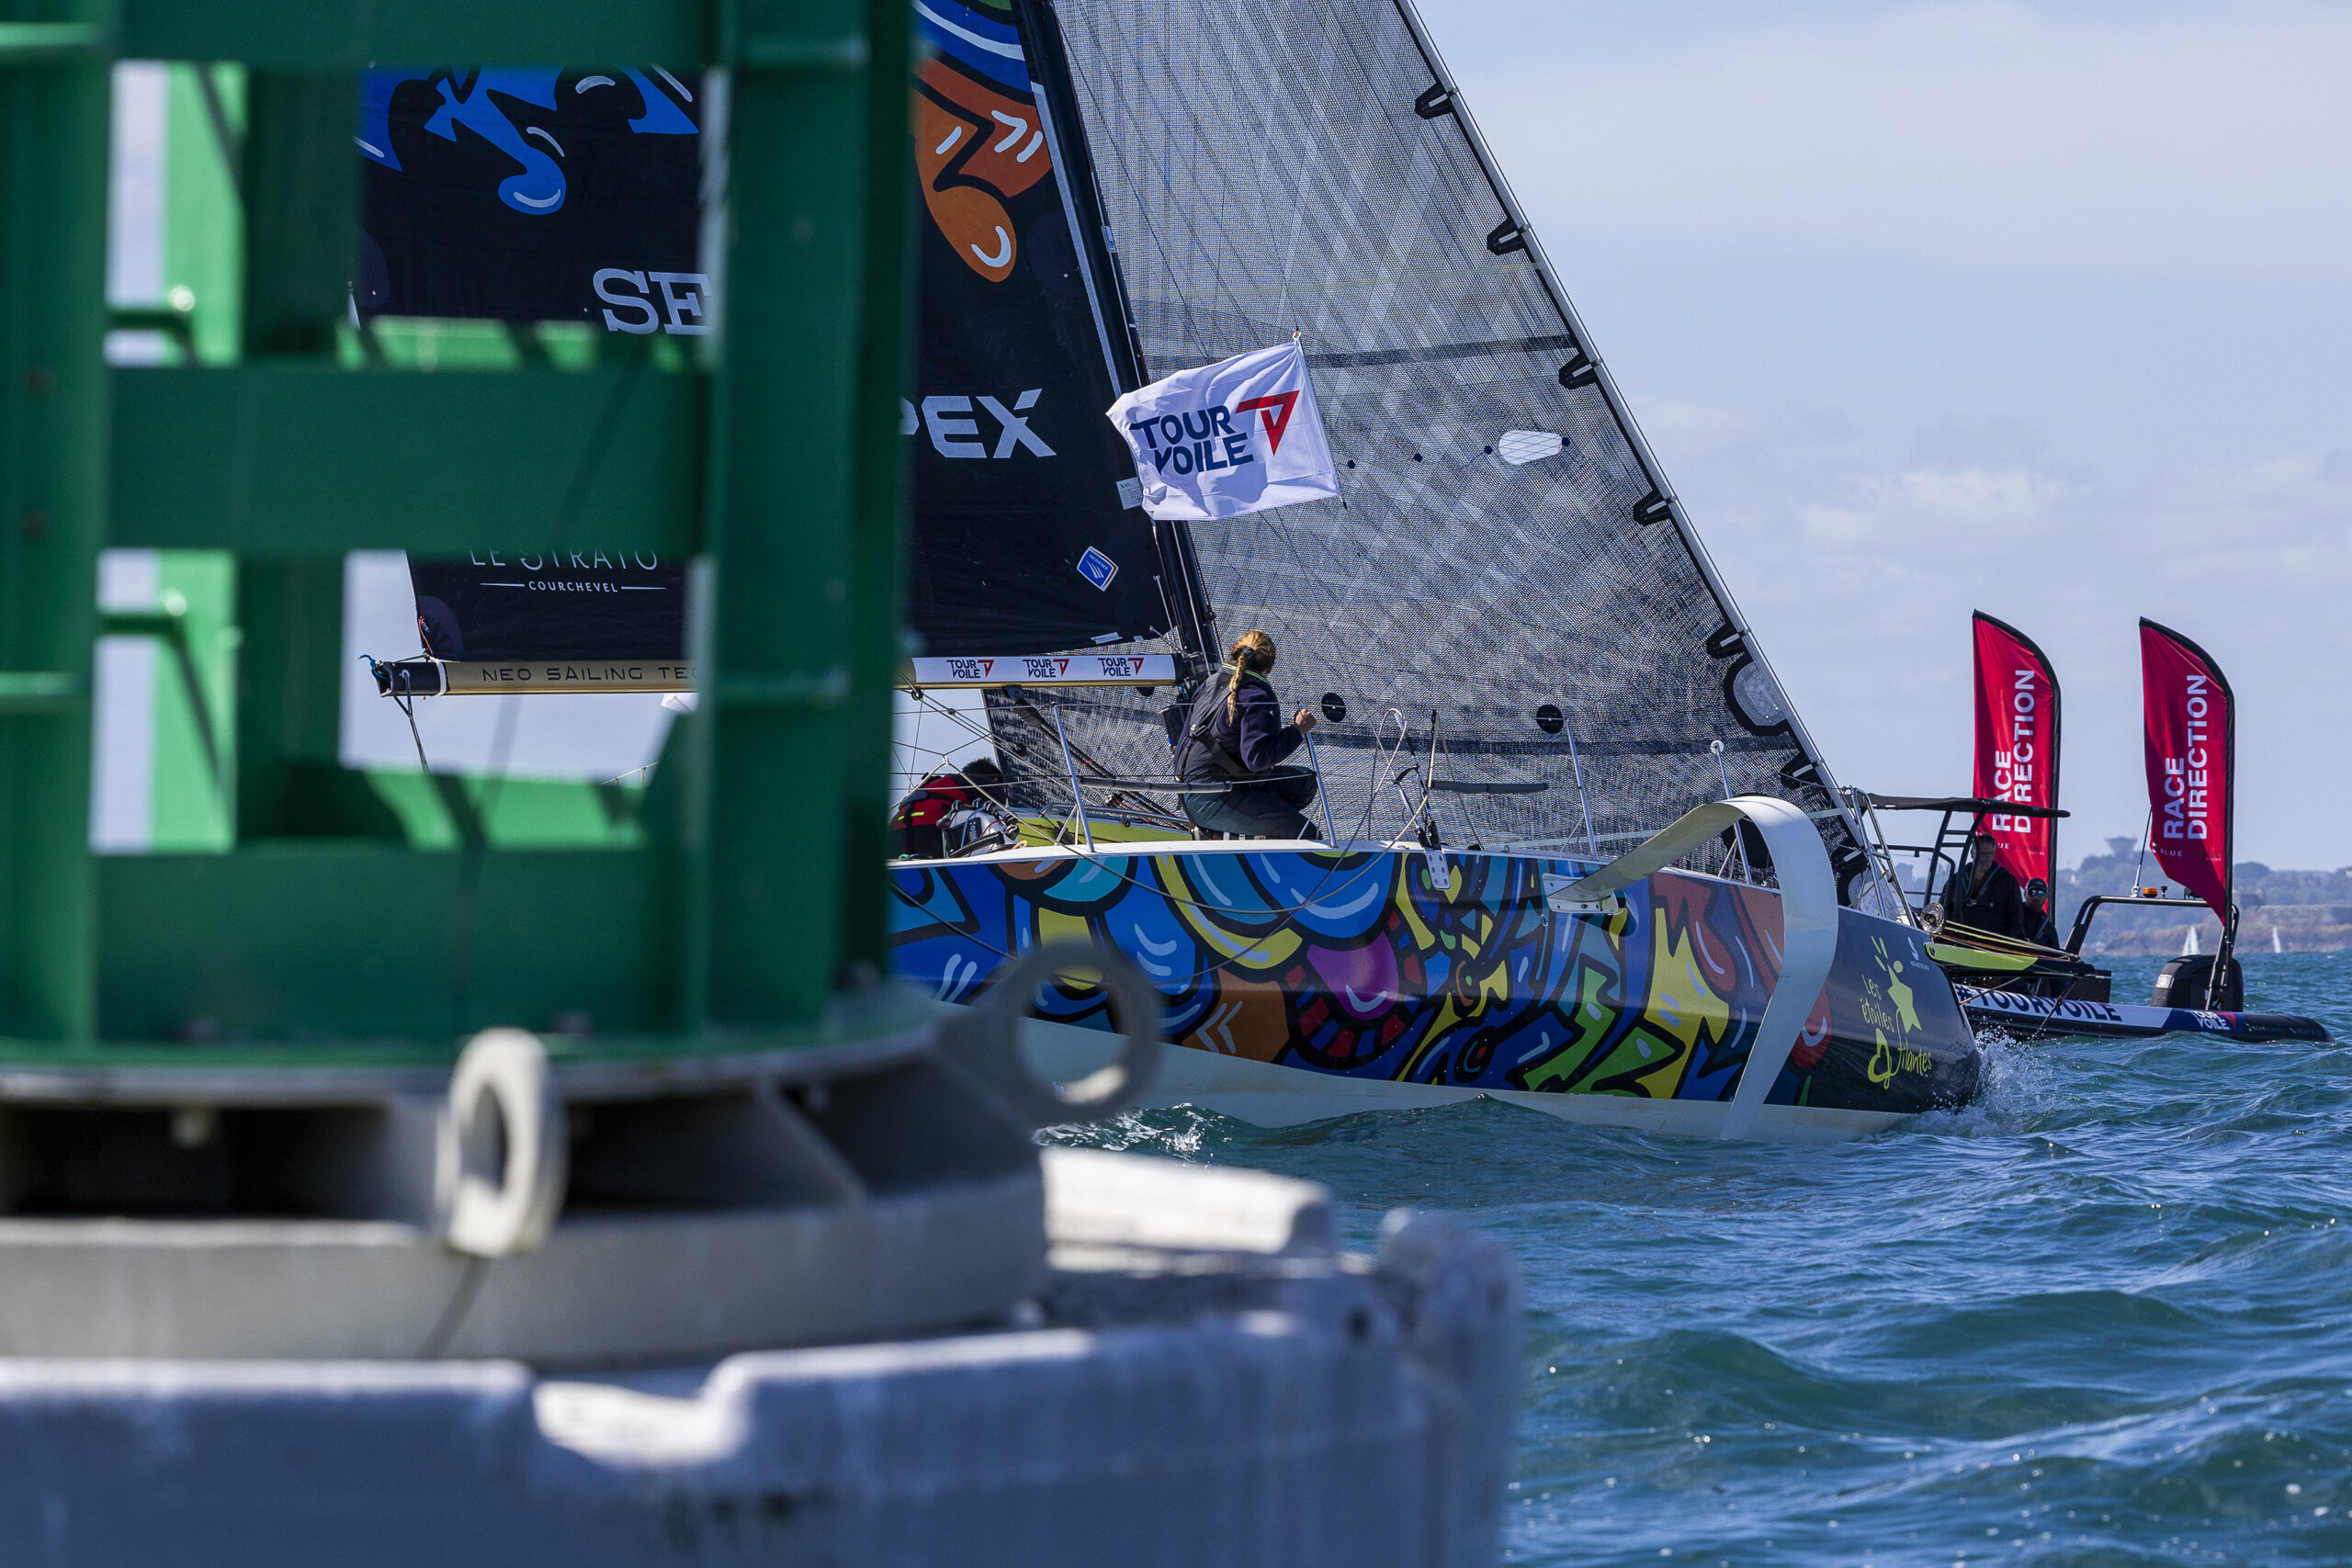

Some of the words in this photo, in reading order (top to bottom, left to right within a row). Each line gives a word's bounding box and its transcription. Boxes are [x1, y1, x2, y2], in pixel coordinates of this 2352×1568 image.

[899, 388, 1057, 458] EX
[1129, 405, 1237, 448] TOUR
[1155, 433, 1254, 476] VOILE
[528, 581, 618, 592] COURCHEVEL
[946, 660, 978, 669] TOUR
[1022, 659, 1053, 669] TOUR
[1097, 657, 1127, 667] TOUR
[482, 668, 531, 682] NEO
[547, 665, 643, 681] SAILING
[953, 669, 980, 678] VOILE
[1028, 668, 1057, 678] VOILE
[1103, 666, 1131, 676] VOILE
[2013, 670, 2034, 833] DRECTION
[2187, 675, 2208, 839] DIRECTION
[2164, 758, 2185, 839] RACE
[1954, 984, 2122, 1021] #TOURVOILE
[2197, 1017, 2230, 1030] VOILE
